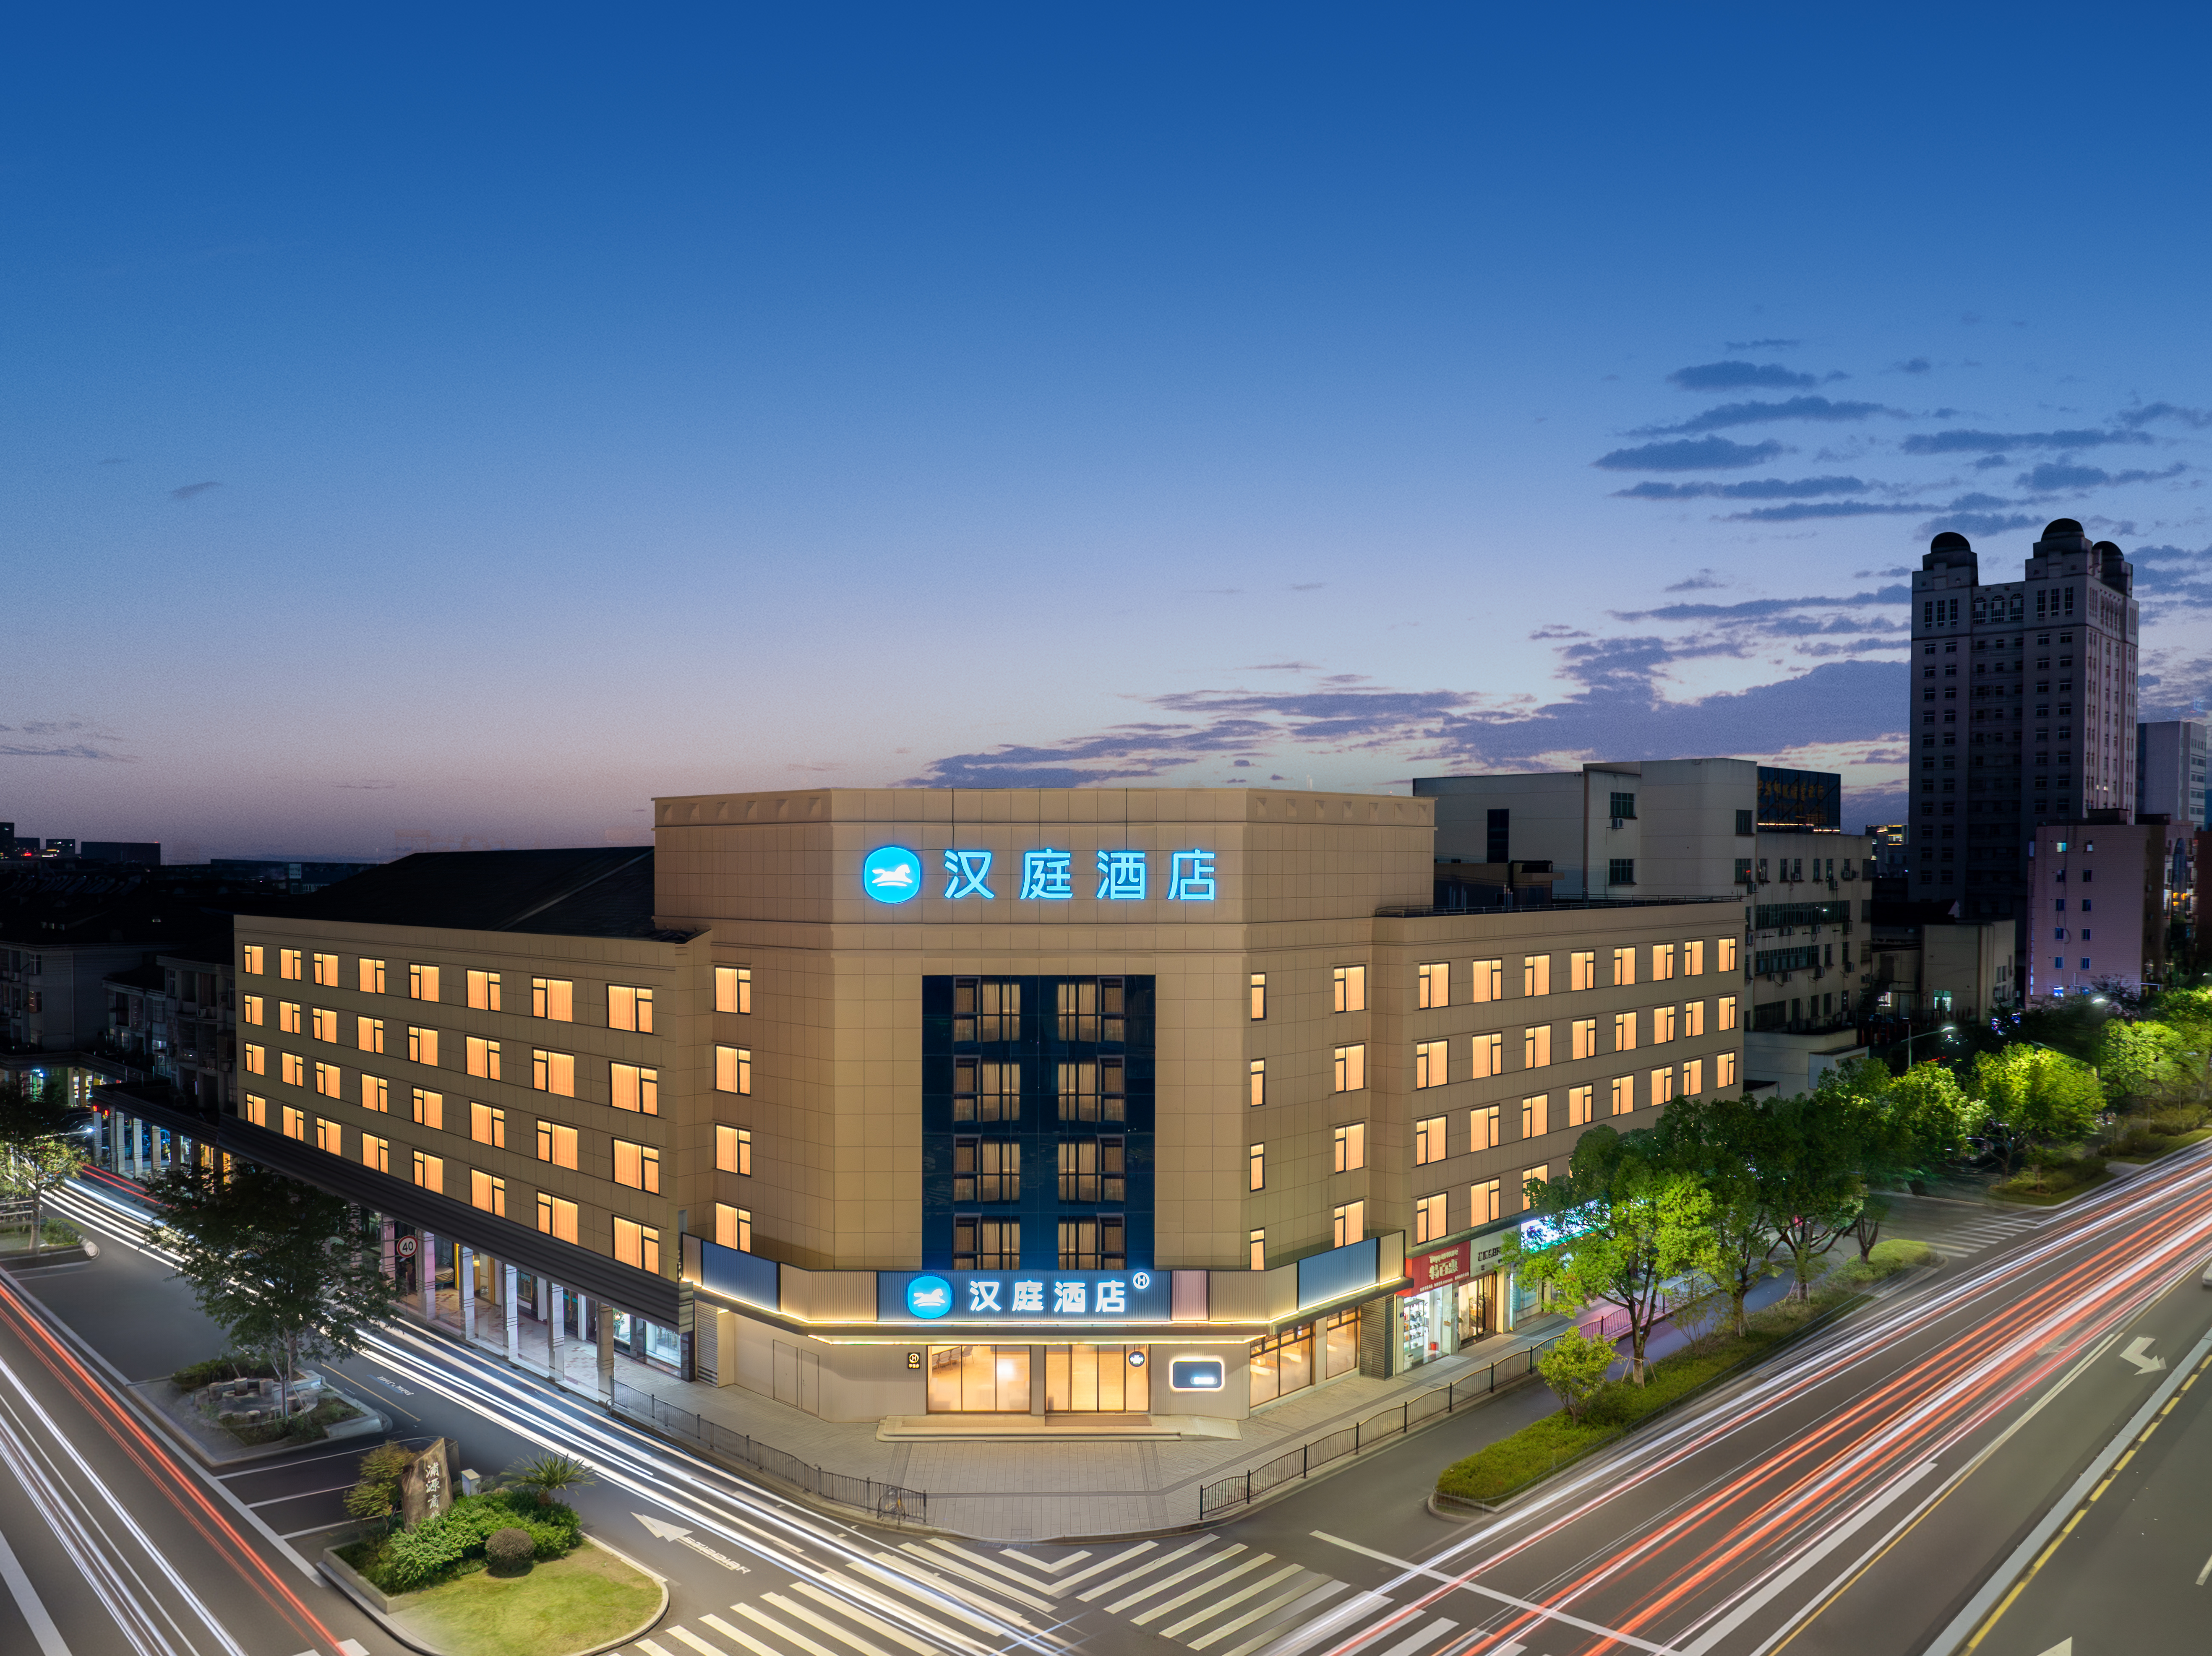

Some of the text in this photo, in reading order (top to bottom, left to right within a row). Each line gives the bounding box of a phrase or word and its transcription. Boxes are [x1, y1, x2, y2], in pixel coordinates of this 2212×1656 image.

[944, 849, 1216, 900] 汉庭酒店
[402, 1241, 414, 1252] 40
[969, 1280, 1125, 1312] 汉庭酒店
